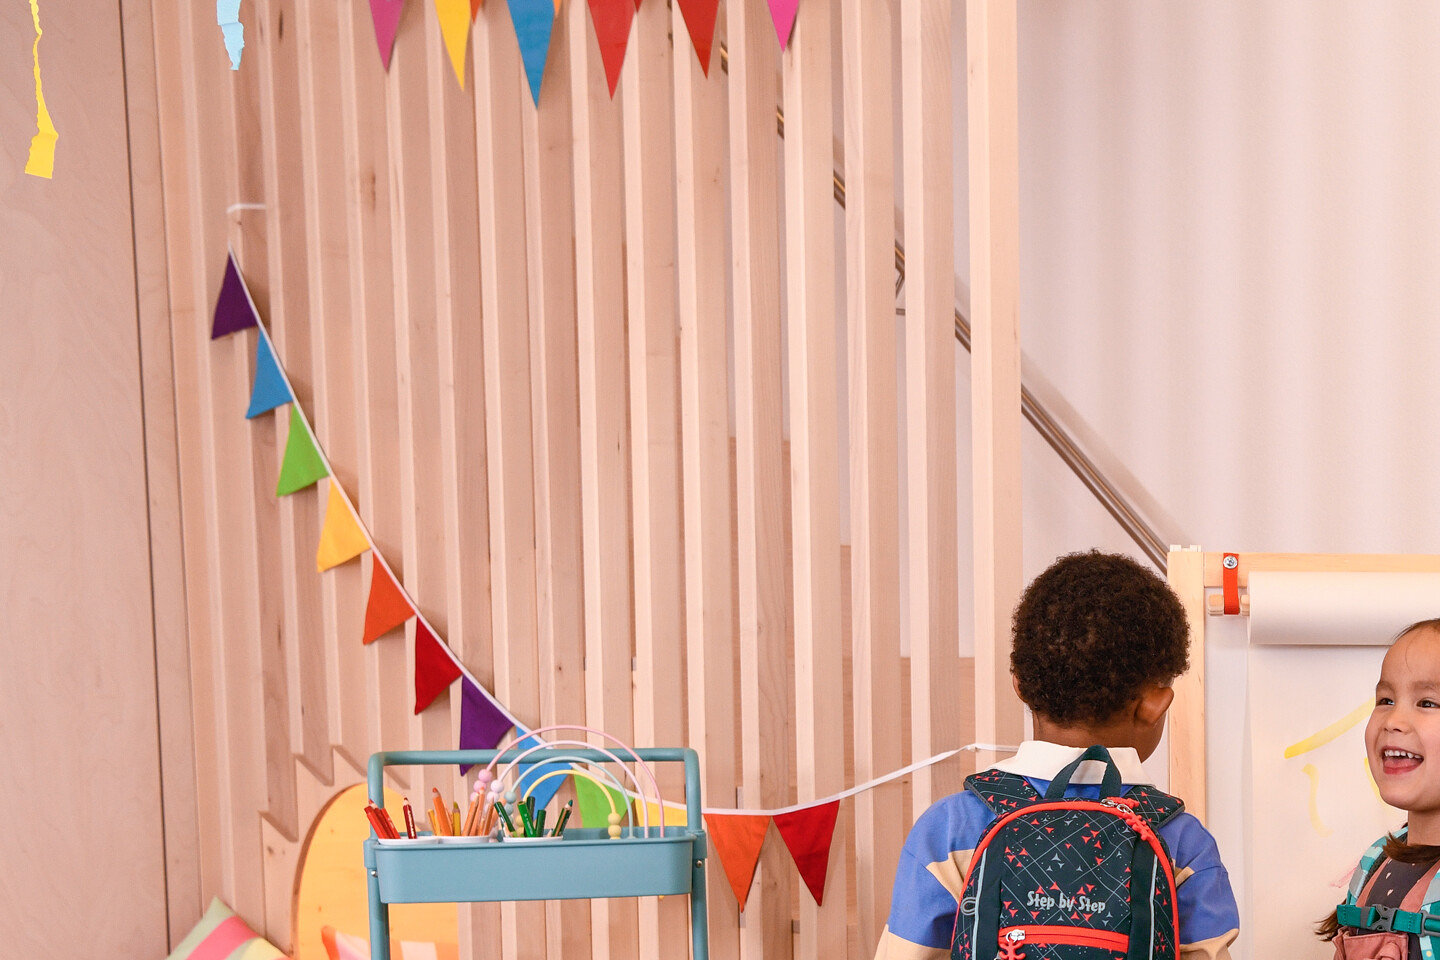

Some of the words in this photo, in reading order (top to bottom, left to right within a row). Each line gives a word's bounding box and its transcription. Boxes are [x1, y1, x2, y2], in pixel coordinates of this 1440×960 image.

[1027, 890, 1055, 910] Step
[1059, 892, 1075, 912] by
[1078, 895, 1106, 914] Step
